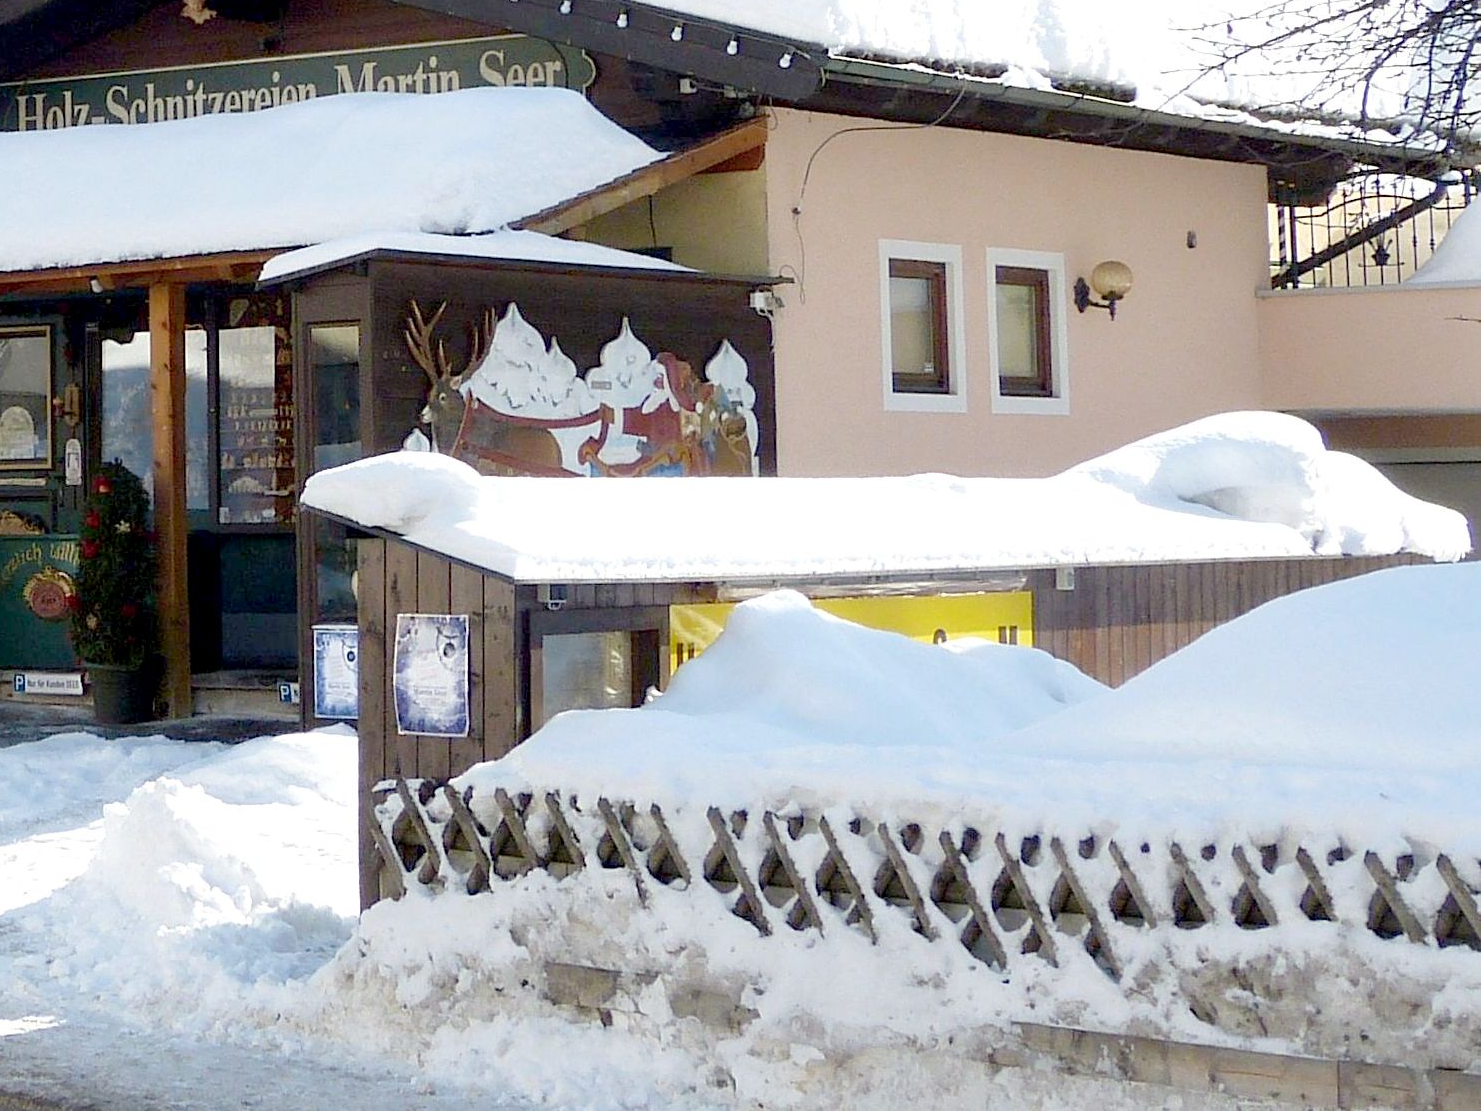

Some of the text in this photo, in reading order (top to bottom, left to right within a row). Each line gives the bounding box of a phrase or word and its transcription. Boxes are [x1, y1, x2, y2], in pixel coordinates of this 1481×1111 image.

[16, 49, 562, 131] Holz-Schnitzereien Martin Seer
[15, 675, 24, 691] P
[280, 685, 289, 701] P
